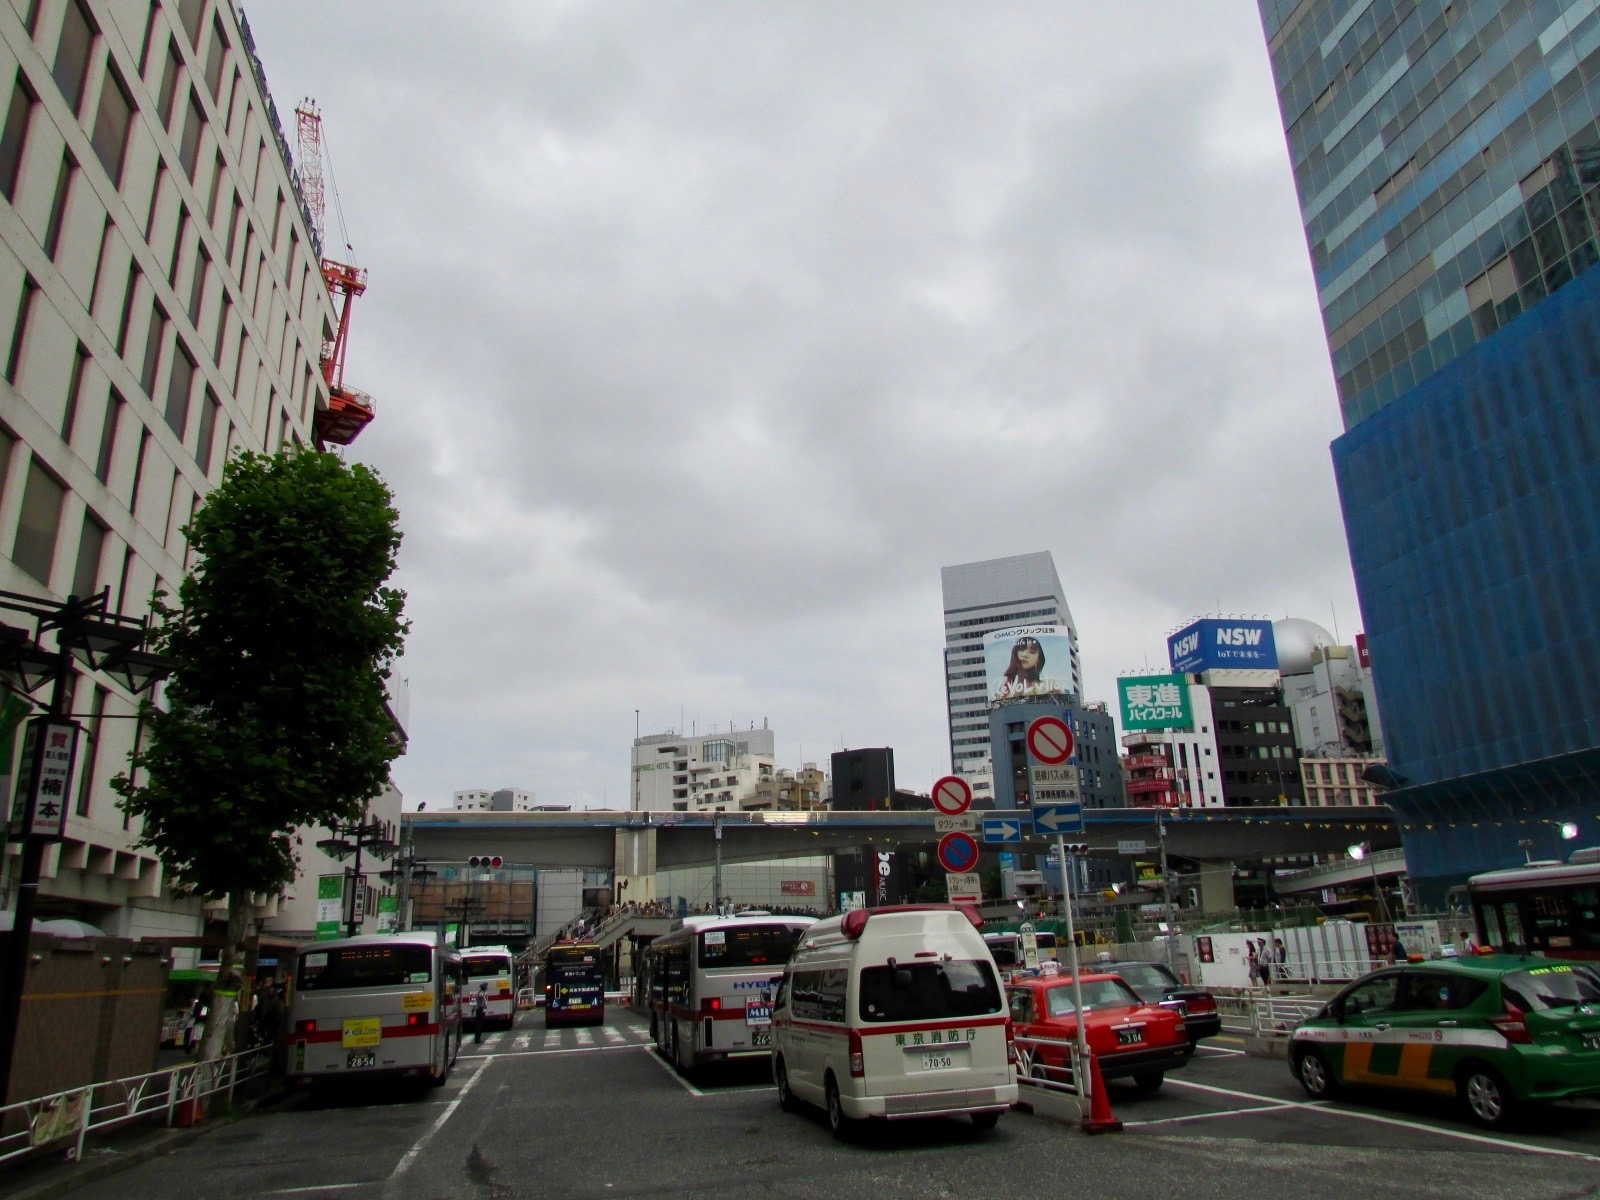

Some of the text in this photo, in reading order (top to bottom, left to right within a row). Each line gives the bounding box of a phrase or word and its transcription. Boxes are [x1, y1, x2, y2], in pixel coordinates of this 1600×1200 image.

[994, 627, 1055, 639] GMOクリック証券
[1216, 628, 1261, 645] NSW
[1174, 631, 1199, 660] NSW
[1126, 682, 1182, 708] 東進
[1129, 708, 1183, 721] ハイスクール
[1034, 769, 1075, 781] 路線バスを除く
[879, 877, 887, 901] MUSIC
[895, 1028, 976, 1046] 東京消防庁
